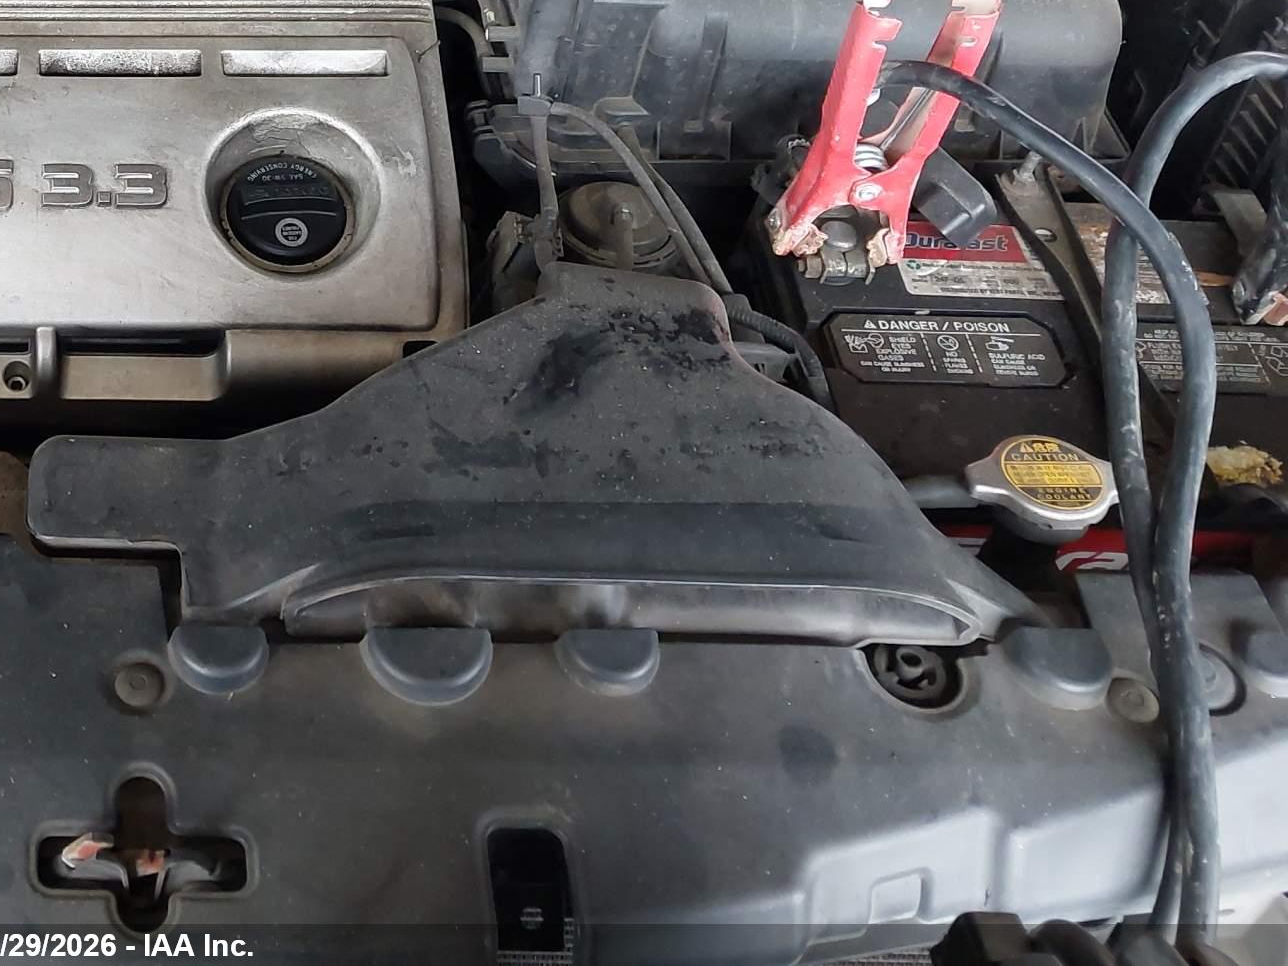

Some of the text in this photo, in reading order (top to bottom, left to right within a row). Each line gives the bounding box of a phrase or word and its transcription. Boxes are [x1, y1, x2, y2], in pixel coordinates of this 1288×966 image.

[40, 162, 168, 210] 3.3
[878, 320, 1010, 333] DANGER / POISON
[1011, 453, 1080, 462] CAUTION
